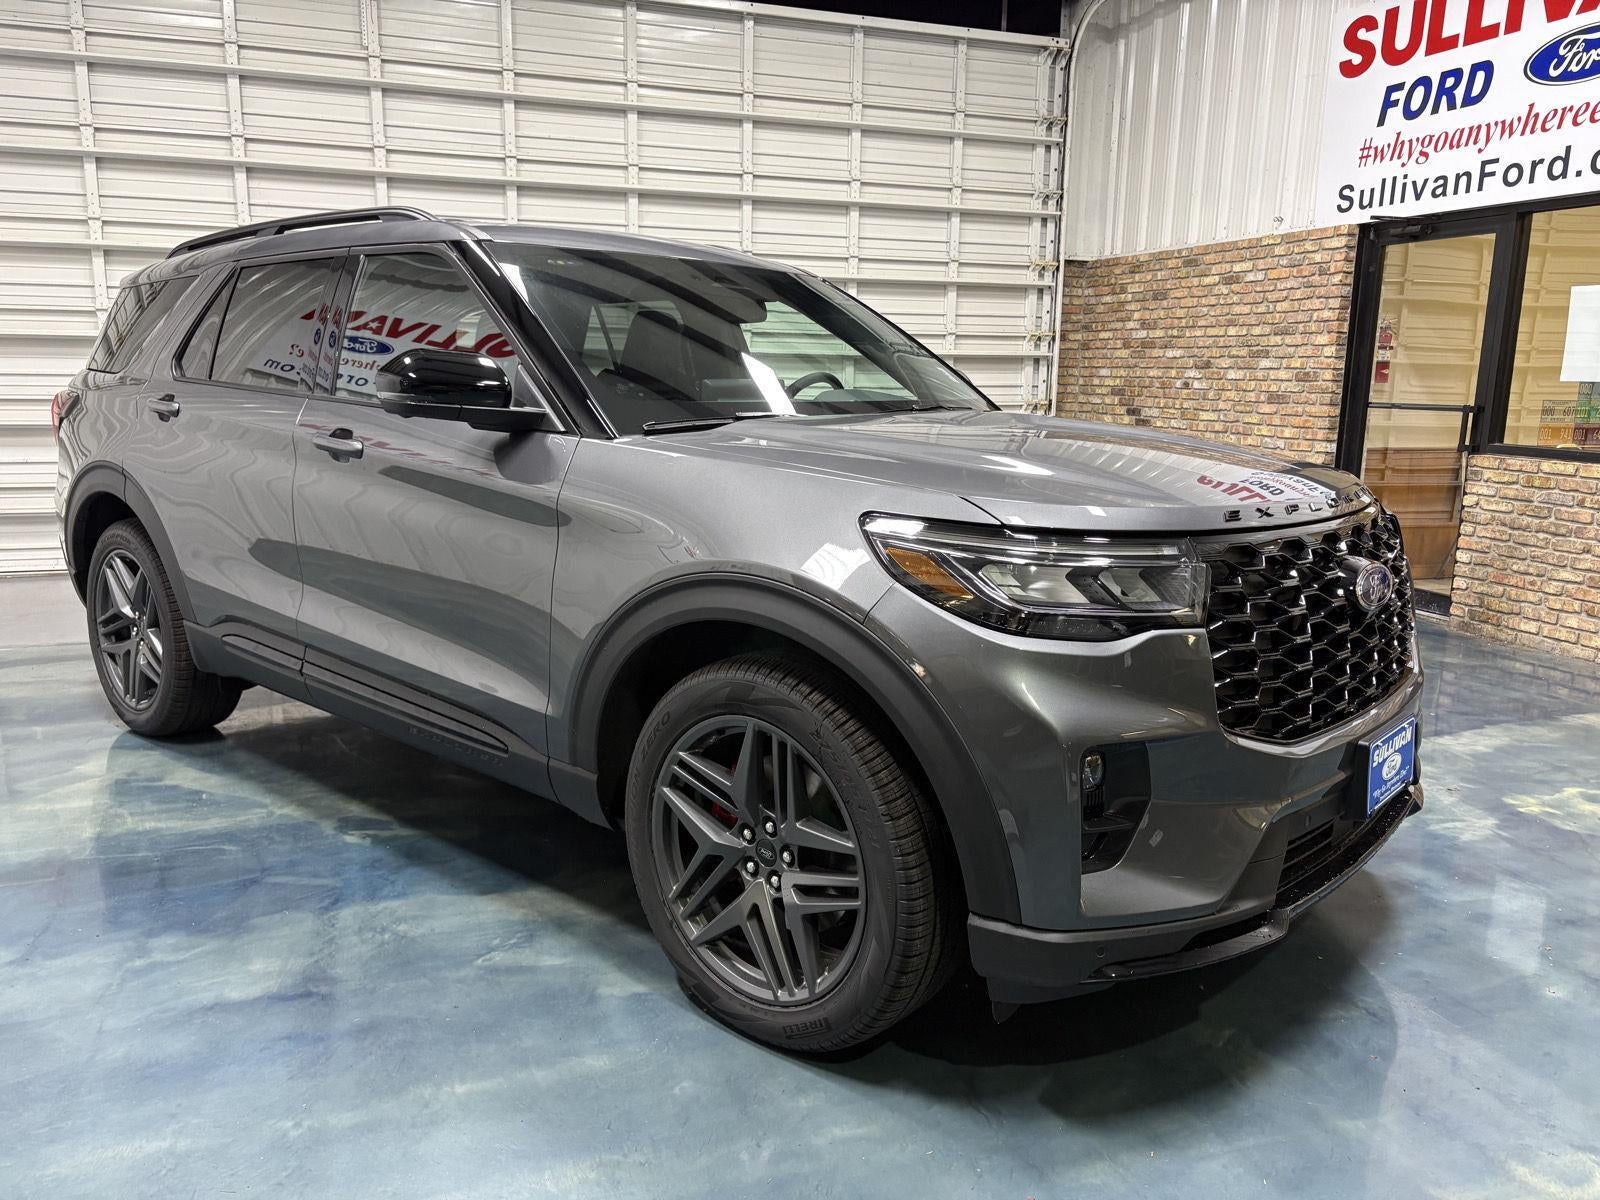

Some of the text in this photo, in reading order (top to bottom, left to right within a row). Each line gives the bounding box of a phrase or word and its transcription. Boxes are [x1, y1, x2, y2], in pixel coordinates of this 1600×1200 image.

[1549, 32, 1600, 77] For
[1376, 59, 1495, 128] FORD
[1372, 726, 1413, 768] SULLIVAN
